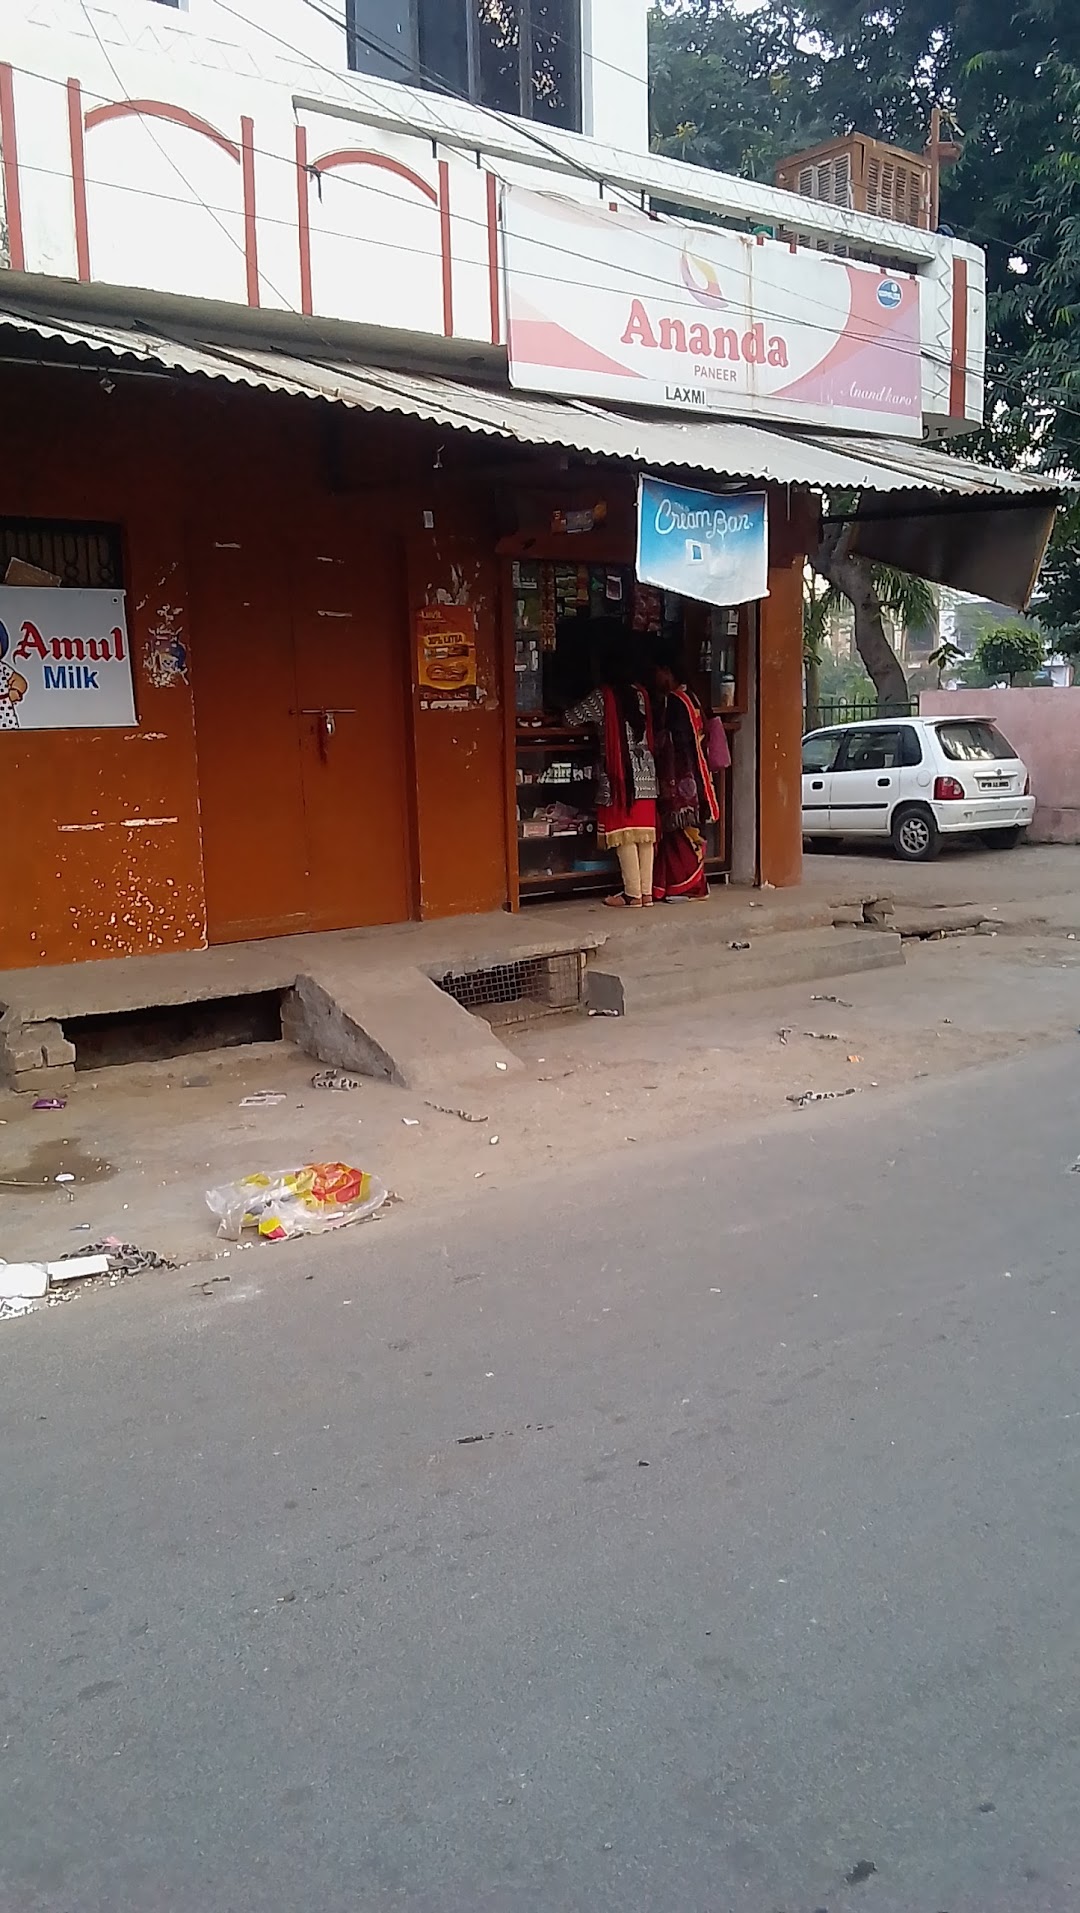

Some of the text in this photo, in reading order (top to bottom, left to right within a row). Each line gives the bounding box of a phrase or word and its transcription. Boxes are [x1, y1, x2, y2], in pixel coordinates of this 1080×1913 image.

[620, 298, 789, 368] Ananda
[693, 364, 737, 382] PANEER
[664, 385, 706, 405] LAXMI
[655, 499, 750, 539] Cream Bar
[12, 620, 127, 664] Amul
[43, 665, 99, 690] Milk
